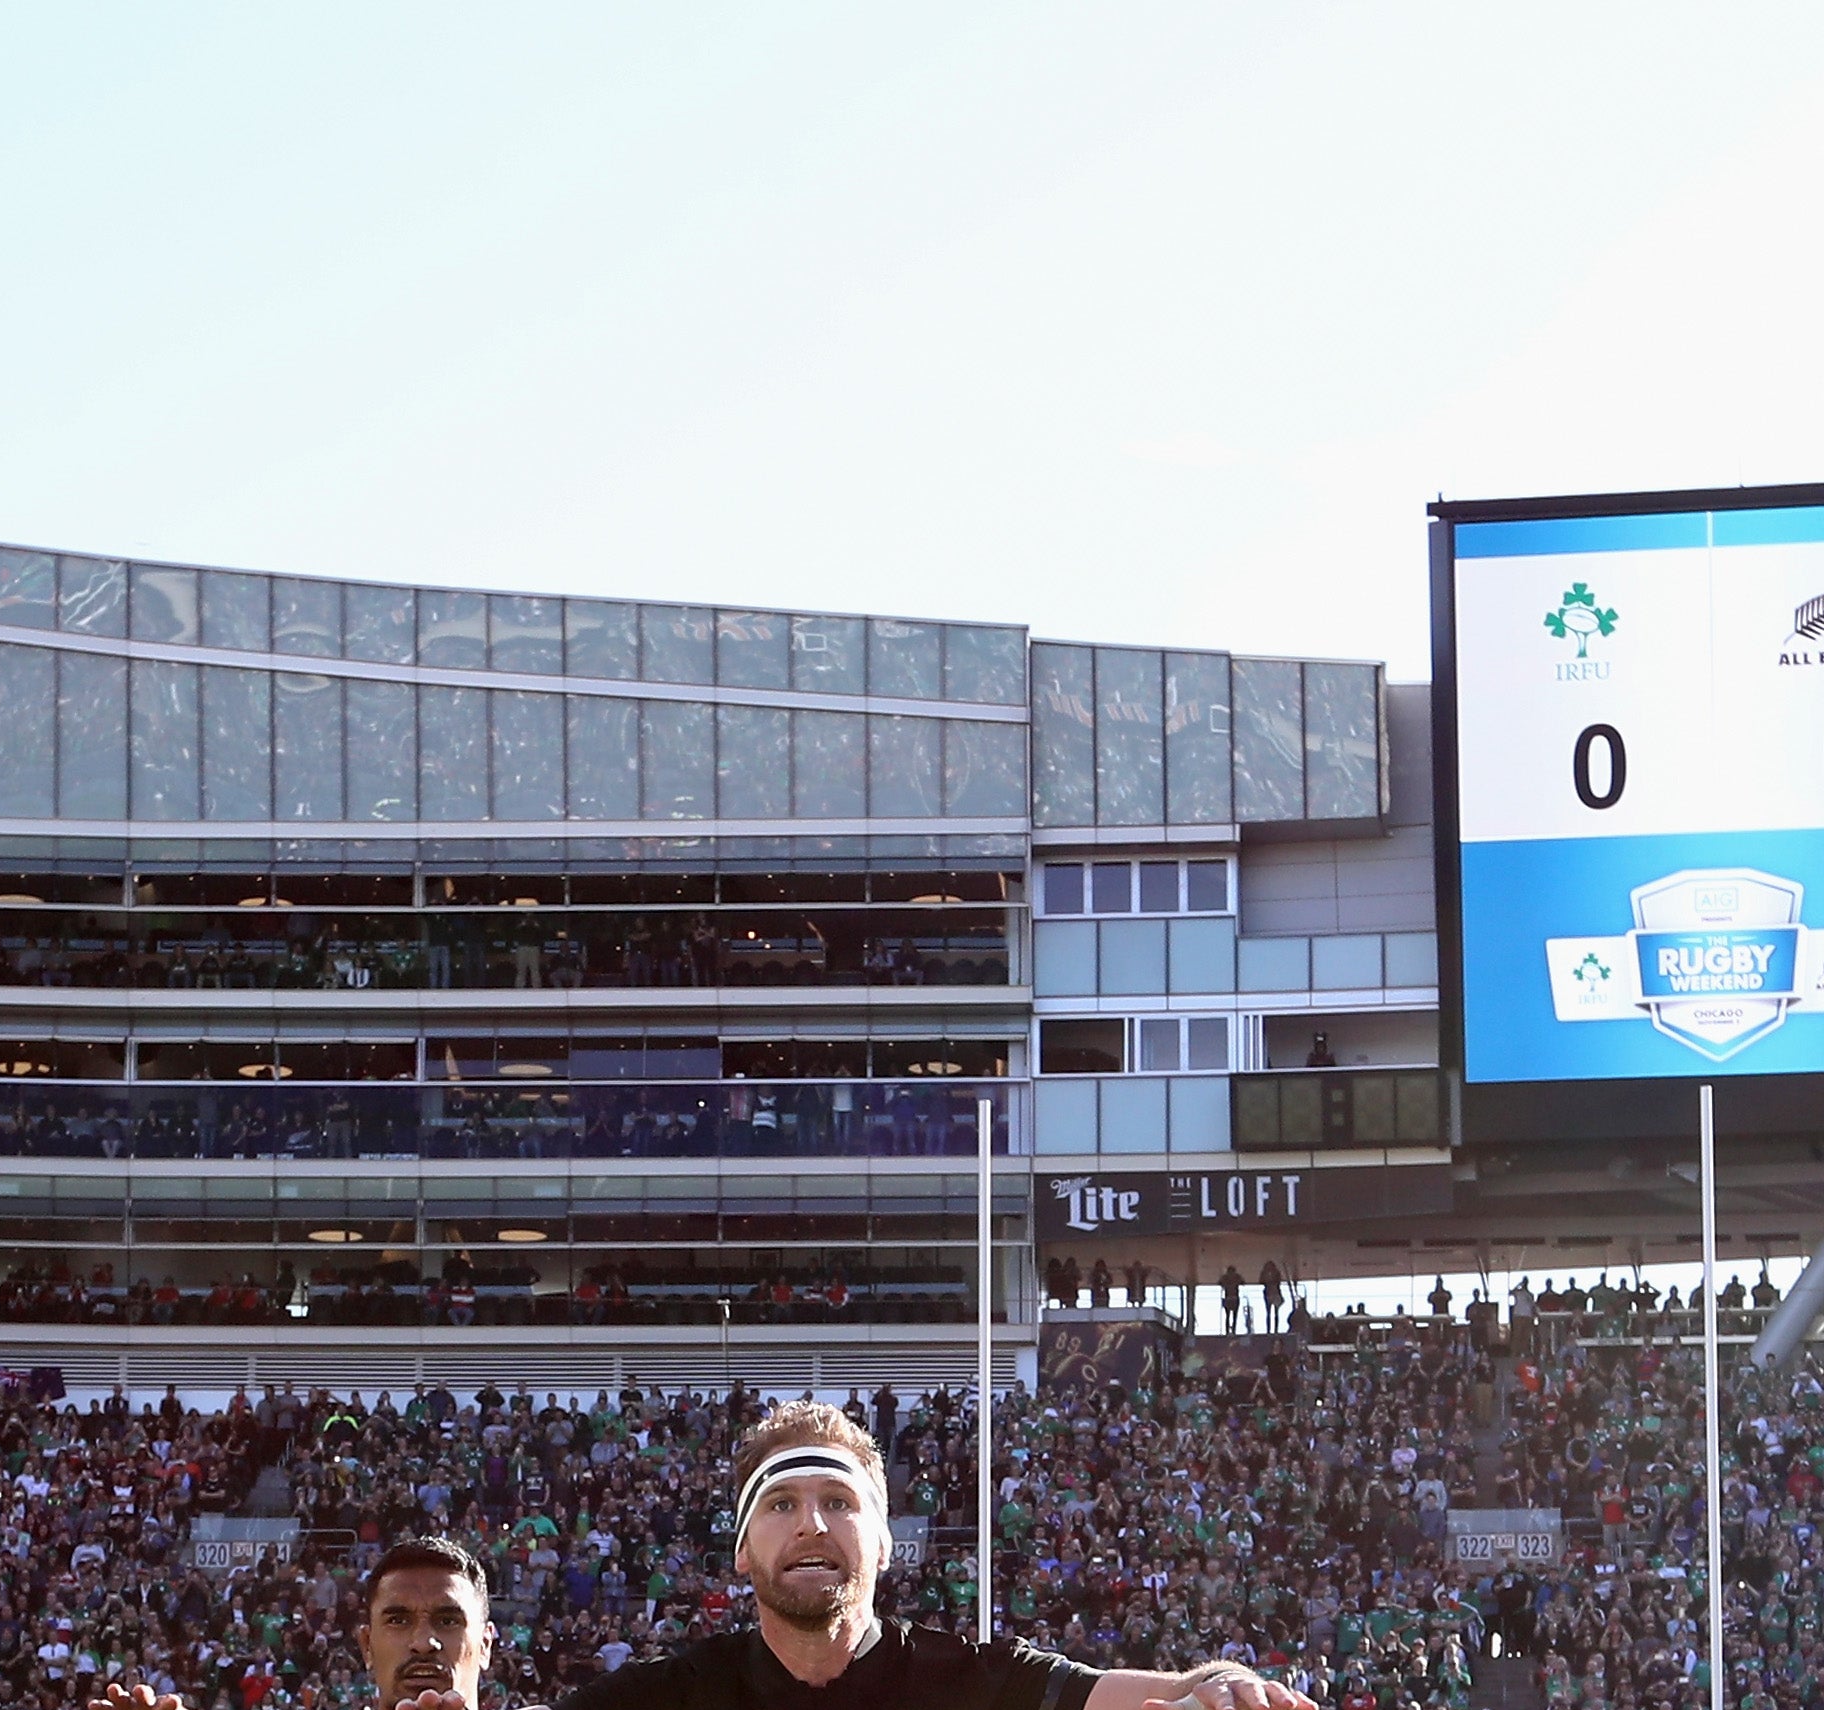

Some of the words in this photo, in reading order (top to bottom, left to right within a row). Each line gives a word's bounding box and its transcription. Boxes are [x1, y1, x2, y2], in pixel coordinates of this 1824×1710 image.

[1778, 652, 1812, 666] ALL
[1555, 662, 1610, 681] IRFU
[1574, 723, 1626, 810] 0
[1700, 890, 1733, 906] AIG
[1706, 936, 1728, 946] THE
[1657, 944, 1775, 976] RUGBY
[1669, 973, 1764, 992] WEEKEND
[1694, 1009, 1743, 1019] CHICAGO
[1170, 1177, 1191, 1188] THE
[1201, 1175, 1301, 1217] LOFT
[1066, 1186, 1140, 1231] Lite
[198, 1544, 227, 1565] 320
[1459, 1537, 1489, 1558] 322
[1521, 1535, 1550, 1556] 323
